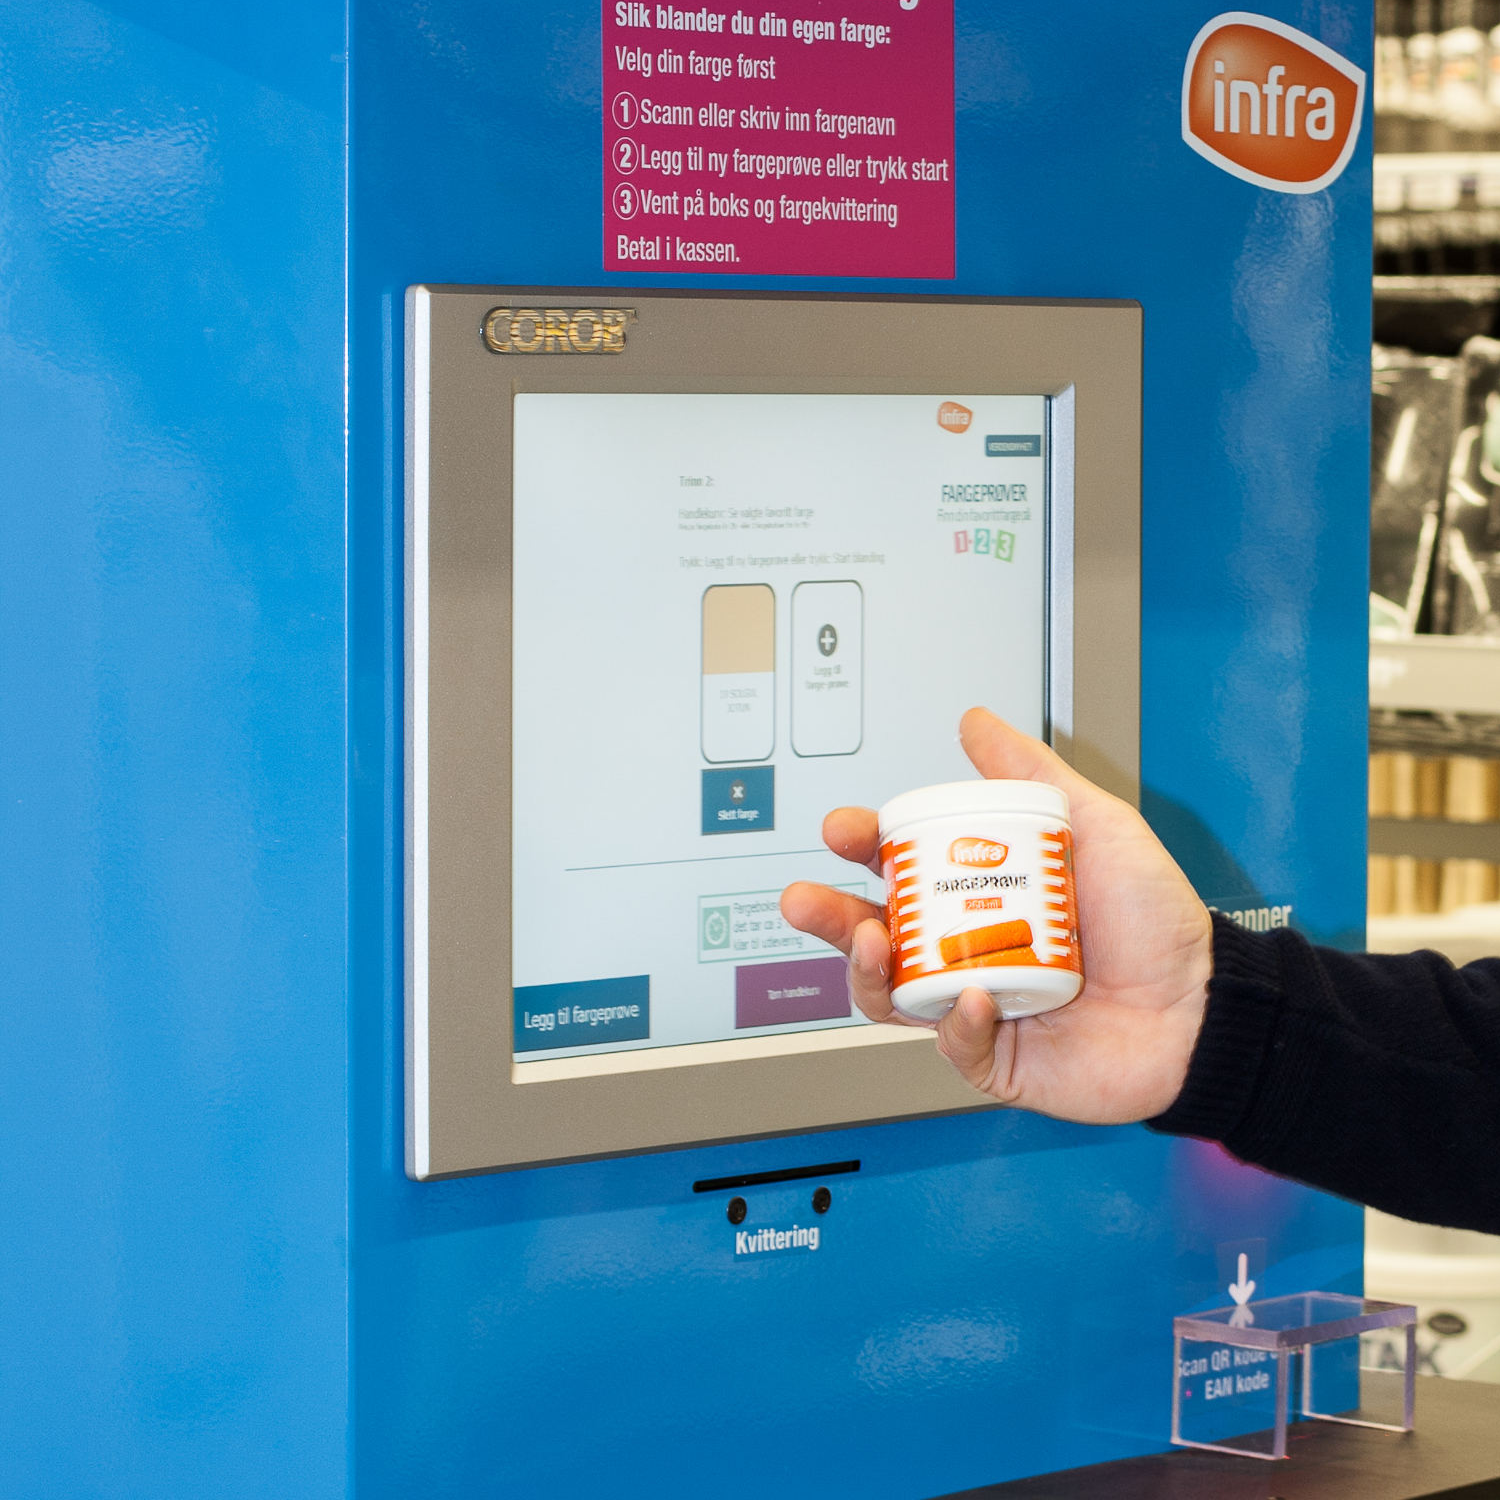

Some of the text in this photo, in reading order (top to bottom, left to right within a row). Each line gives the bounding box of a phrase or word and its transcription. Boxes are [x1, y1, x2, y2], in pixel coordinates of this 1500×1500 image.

[615, 1, 891, 49] Slik blander du din egen farge:
[615, 46, 776, 82] Velg din farge først
[1212, 59, 1337, 141] infra
[640, 99, 693, 126] Scann
[698, 103, 736, 128] eller
[740, 105, 780, 131] skriv
[785, 107, 810, 132] inn
[815, 109, 896, 139] fargenavn
[641, 144, 682, 176] Legg
[687, 146, 703, 171] til
[708, 152, 727, 178] ny
[733, 148, 821, 179] fargeprøve
[826, 153, 862, 178] eller
[866, 156, 907, 184] trykk
[912, 158, 949, 182] start
[640, 189, 679, 216] Vent
[683, 189, 704, 220] på
[709, 192, 749, 218] boks
[754, 200, 774, 224] og
[779, 195, 898, 228] fargekvittering
[617, 235, 740, 263] Betal i kassen.
[485, 309, 625, 354] COROB
[954, 842, 1005, 864] infra
[525, 1004, 639, 1031] Legg til fargeprøve
[736, 1224, 820, 1255] Kvittering
[1211, 1350, 1230, 1372] QR
[1205, 1371, 1269, 1400] EAN kode
